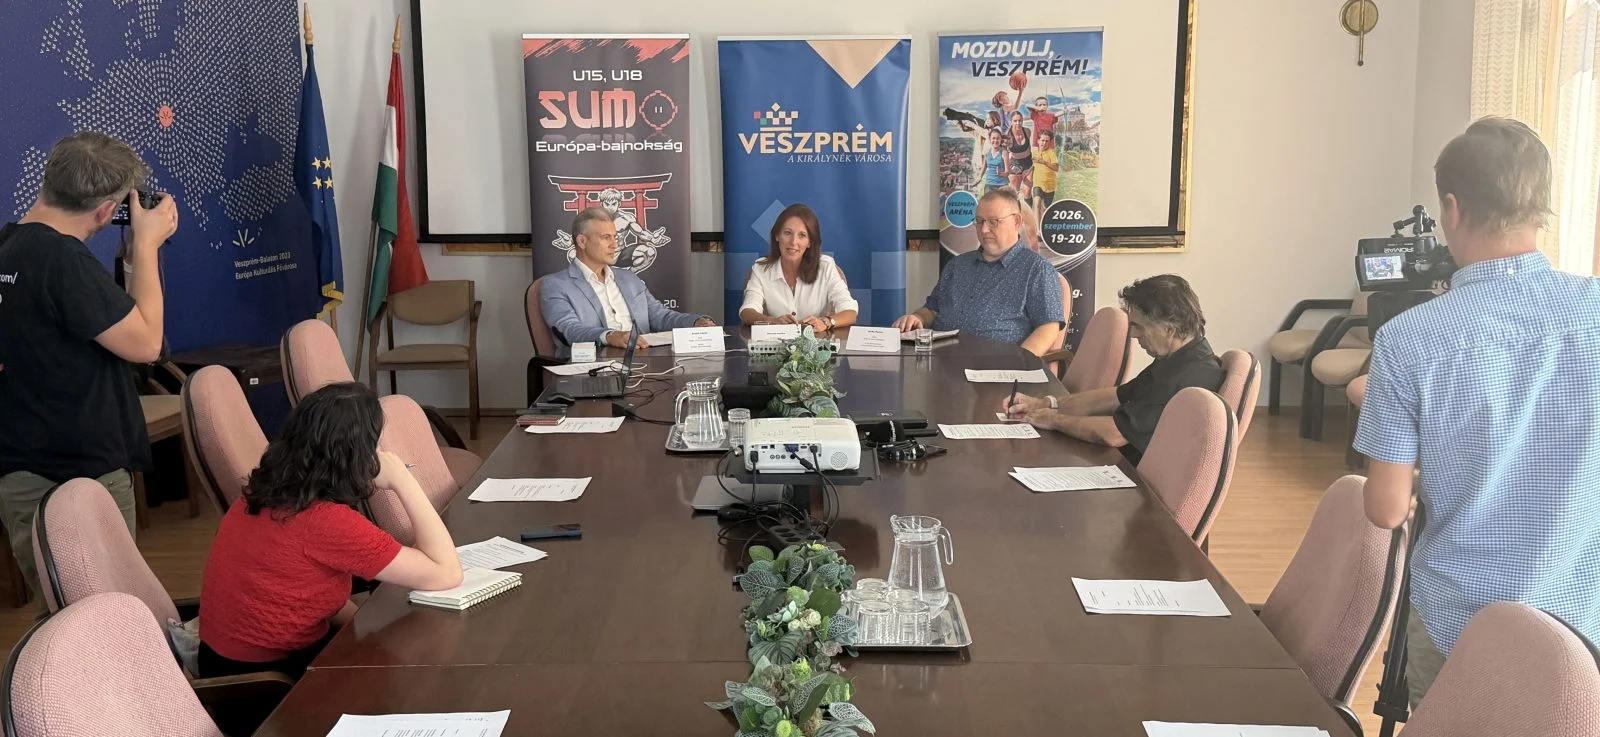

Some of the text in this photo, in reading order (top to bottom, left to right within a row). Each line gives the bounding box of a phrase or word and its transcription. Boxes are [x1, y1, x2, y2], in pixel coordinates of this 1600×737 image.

[951, 39, 1055, 59] MOZDULJ,
[971, 55, 1089, 77] VESZPRÉM!
[573, 69, 643, 83] U15, U18
[538, 88, 679, 131] SUMO
[737, 123, 893, 154] VESZPRÉM
[535, 138, 683, 154] Európa-bajnokság
[787, 152, 892, 163] A KIRÁLYNÉK VÁROSA
[949, 207, 973, 216] ARÉNA
[1051, 209, 1085, 220] 2026.
[1043, 221, 1094, 231] szeptember
[1050, 233, 1086, 244] 19-20.
[235, 270, 253, 280] Európa
